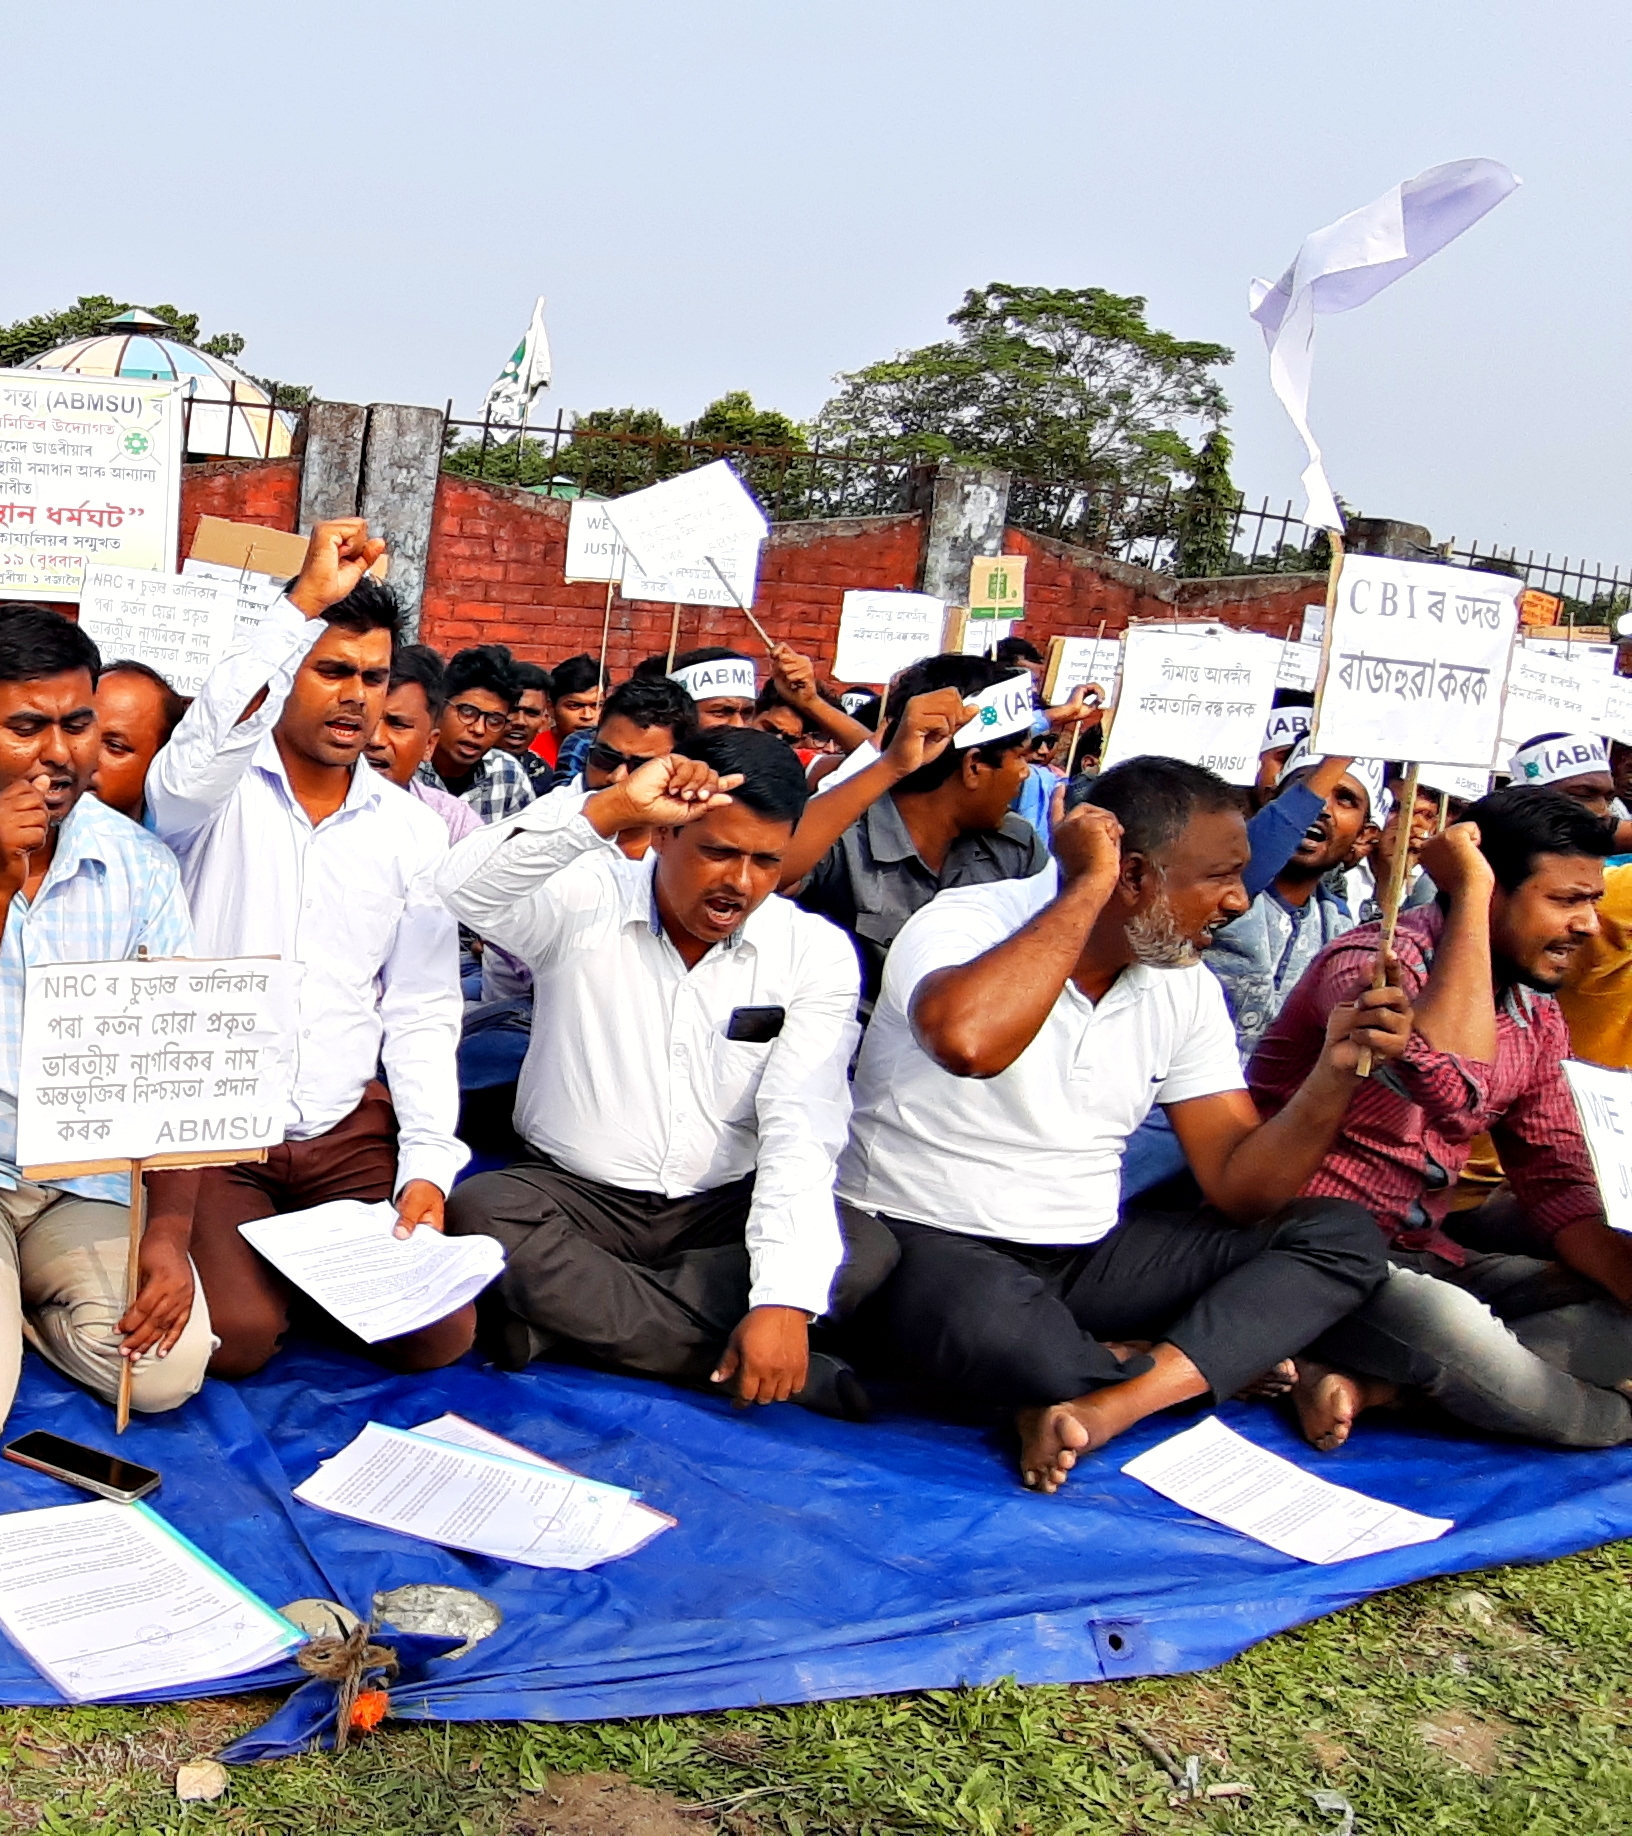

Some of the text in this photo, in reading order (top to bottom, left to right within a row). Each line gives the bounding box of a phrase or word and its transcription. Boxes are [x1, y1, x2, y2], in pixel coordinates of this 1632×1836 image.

[47, 390, 142, 418] (ABMSU)
[93, 573, 123, 589] NRC
[1455, 595, 1501, 630] তদন্ত
[1267, 716, 1309, 740] (AB
[44, 974, 96, 998] NRC
[106, 977, 119, 996] ৰ
[189, 969, 269, 994] তালিকাৰ
[48, 1015, 83, 1039] পৰা
[94, 1006, 143, 1037] কৰ্তন
[151, 1011, 196, 1034] হোৱা
[42, 1042, 259, 1076] ভাৰতীয় নাগৰিকৰ নাম
[1582, 1089, 1625, 1136] WE
[56, 1117, 272, 1144] কৰক ABMSU
